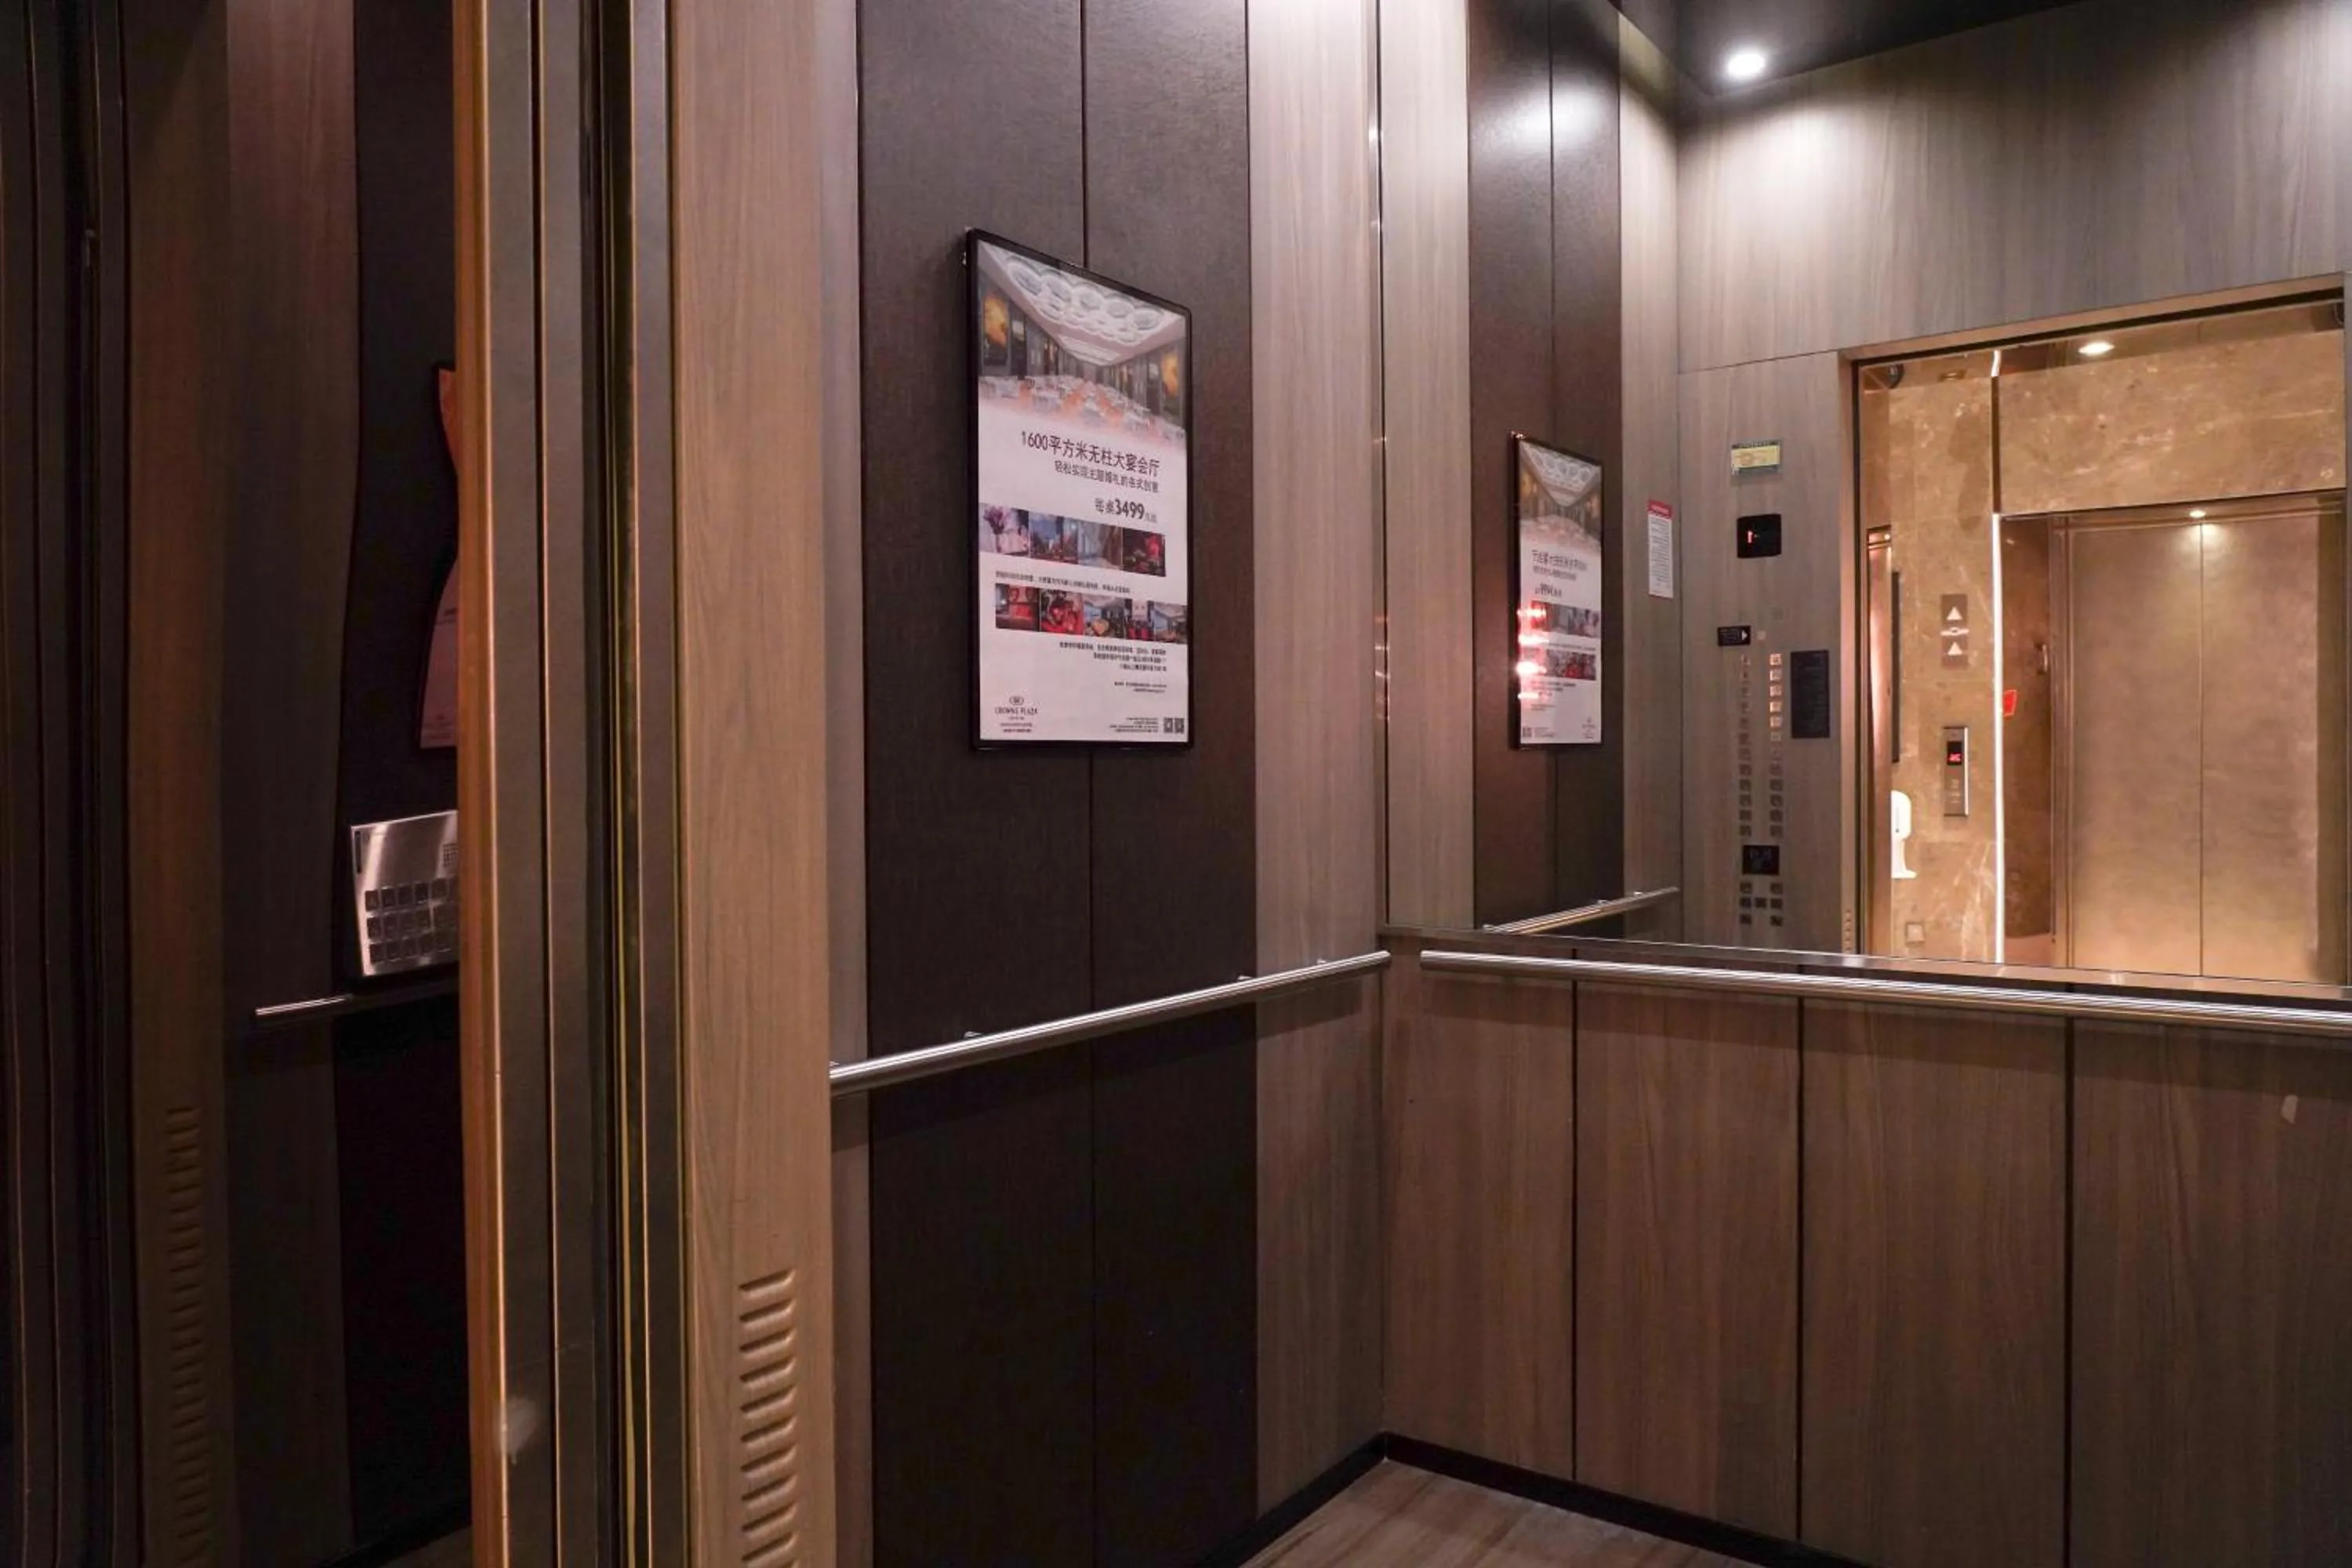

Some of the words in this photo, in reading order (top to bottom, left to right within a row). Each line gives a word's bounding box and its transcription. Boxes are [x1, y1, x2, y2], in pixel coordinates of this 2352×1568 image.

[1022, 430, 1160, 477] 1600平方米无柱大宴会厅
